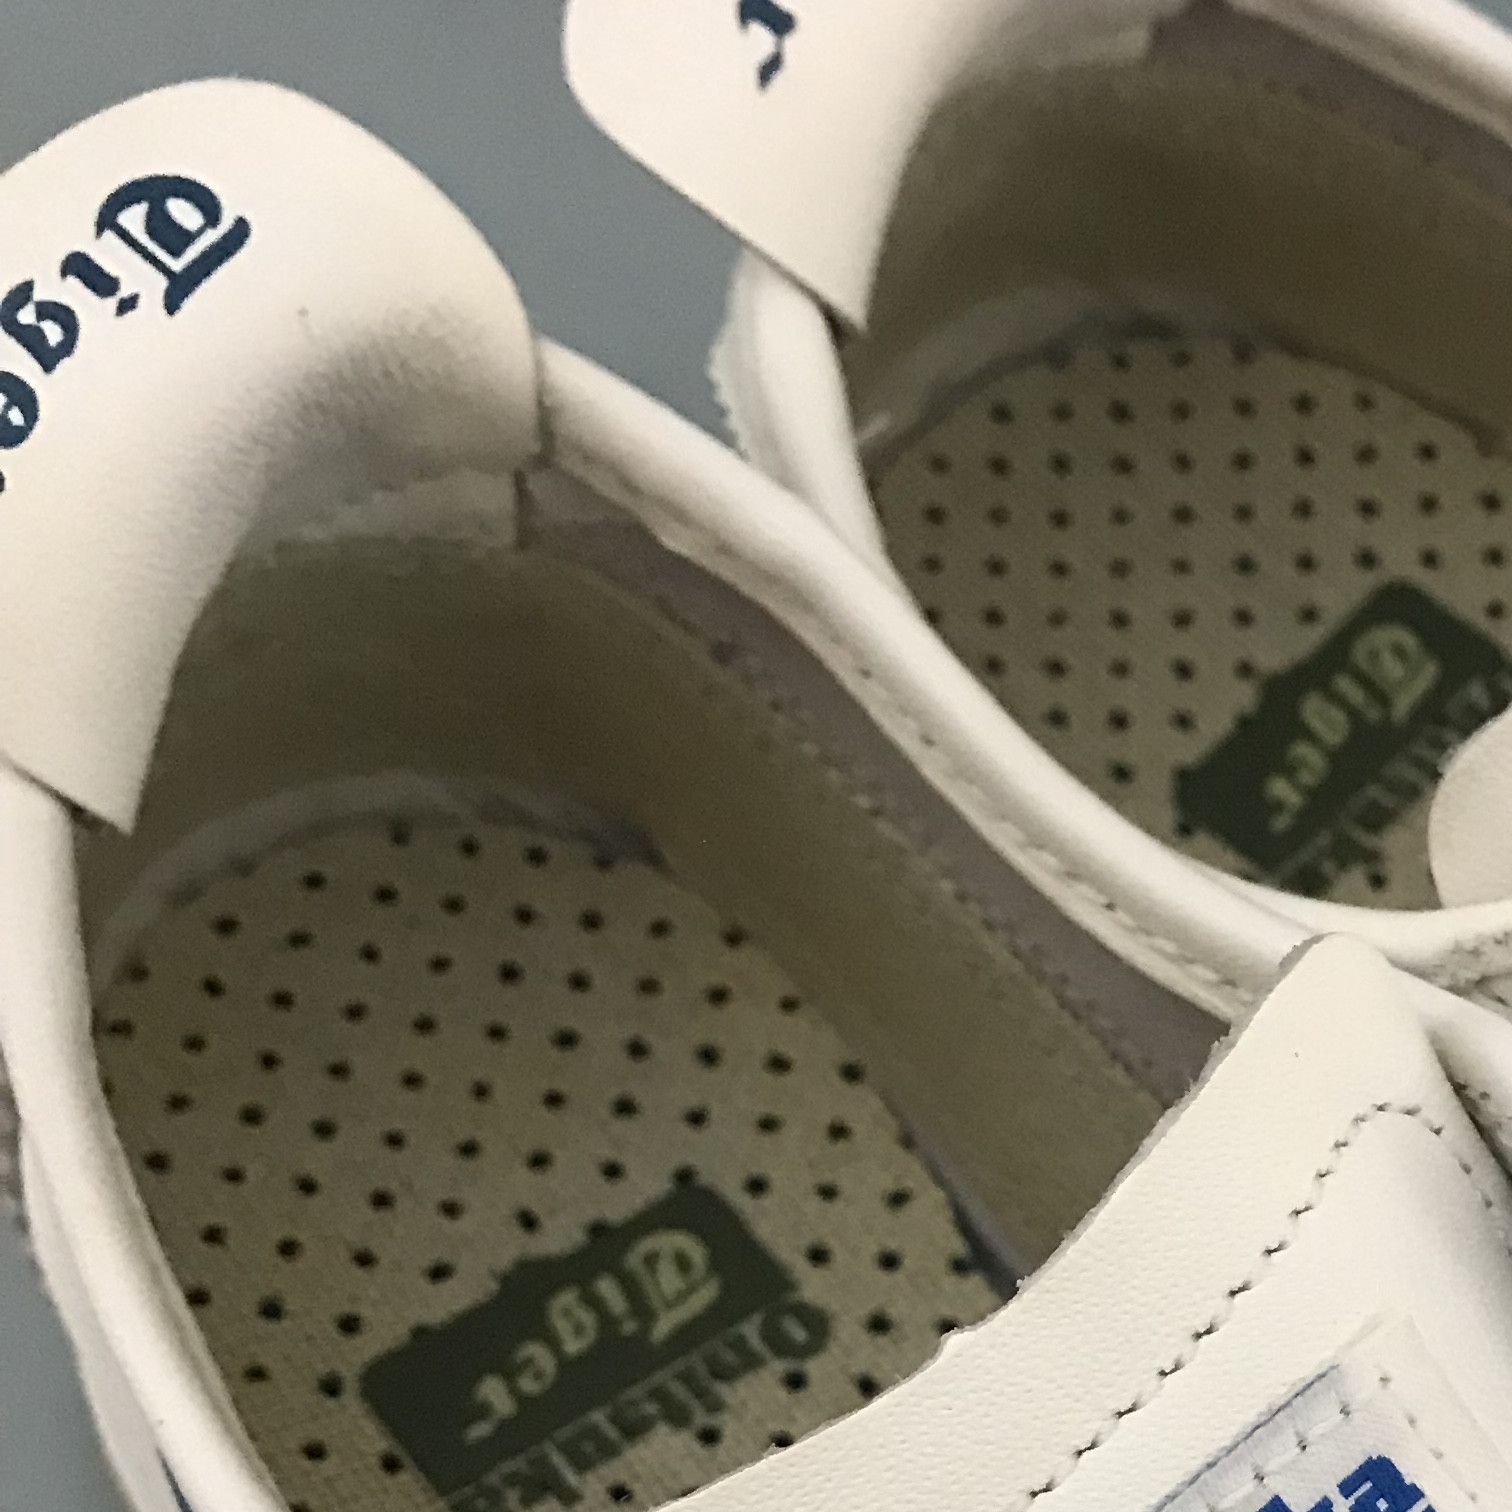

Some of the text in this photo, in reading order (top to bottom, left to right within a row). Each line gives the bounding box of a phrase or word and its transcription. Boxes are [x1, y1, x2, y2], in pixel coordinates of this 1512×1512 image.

[0, 174, 251, 492] Tige
[1264, 623, 1442, 833] Tiger
[462, 1229, 721, 1445] Tiger
